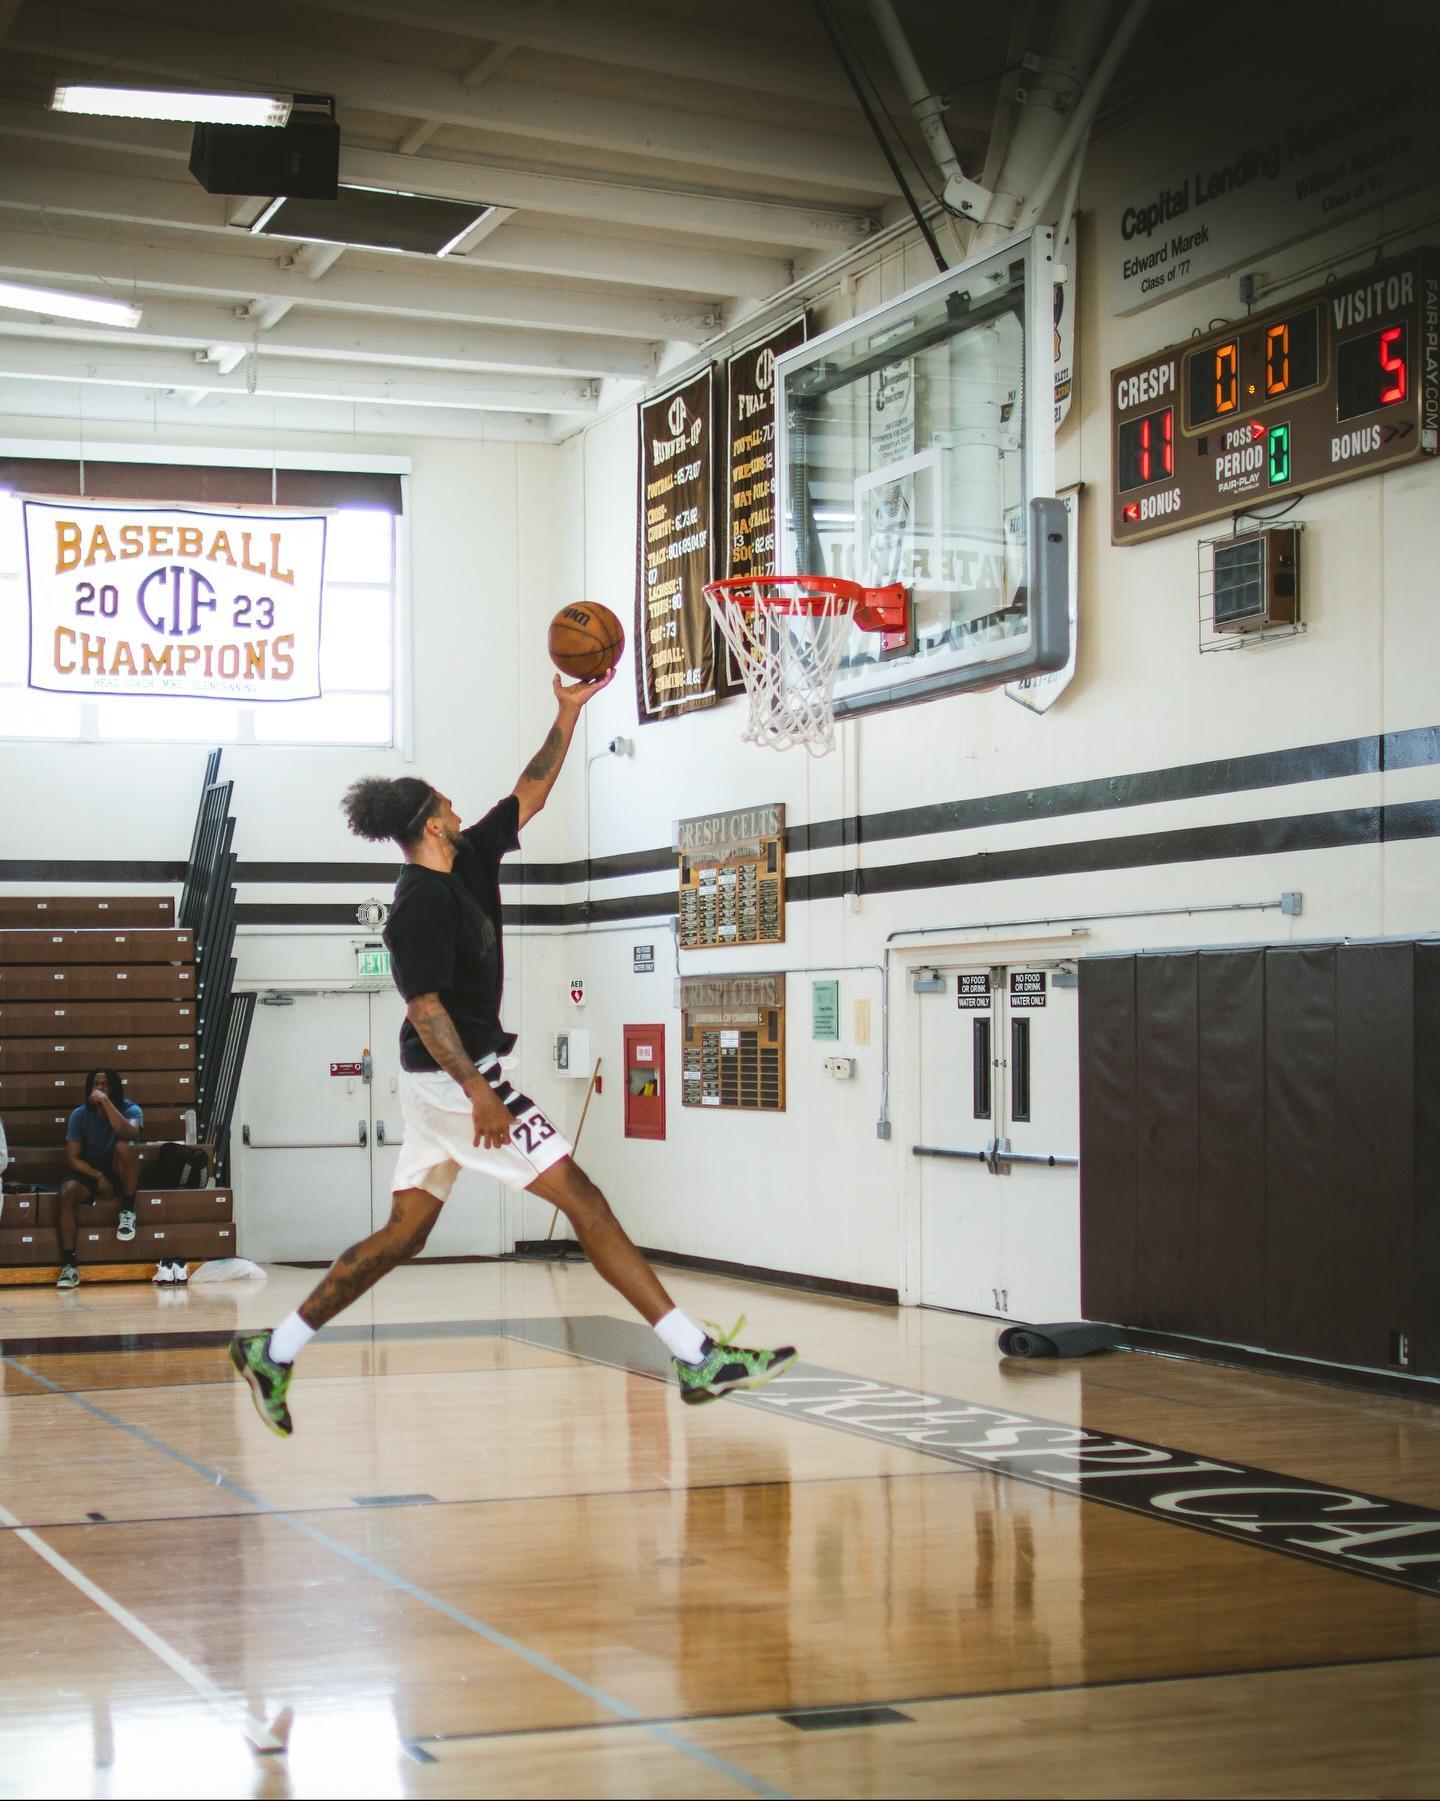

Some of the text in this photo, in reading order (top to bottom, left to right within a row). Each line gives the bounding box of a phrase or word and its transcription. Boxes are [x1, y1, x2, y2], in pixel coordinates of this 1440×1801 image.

[1122, 144, 1282, 240] Capital Lending
[1123, 224, 1210, 280] Edward Marek
[1141, 260, 1191, 292] Class of '77
[1333, 272, 1414, 330] VISITOR
[1380, 327, 1405, 404] 5
[1426, 279, 1438, 430] FAIR-PLAY.COM
[1118, 361, 1175, 410] CRESPI
[668, 396, 687, 436] CIF
[1140, 410, 1173, 481] 11
[1226, 426, 1252, 450] POSS
[1270, 427, 1288, 482] 0
[1332, 425, 1382, 463] BONUS
[1216, 445, 1263, 480] PERIOD
[1218, 472, 1260, 493] FAIR-PLAY
[1140, 488, 1180, 521] BONUS
[55, 520, 294, 586] BASEBALL
[75, 565, 275, 636] 20 CIF 23
[54, 625, 294, 680] CHAMPIONS
[678, 808, 778, 848] CRESPI CELTS
[971, 976, 985, 984] FOOD
[1024, 983, 1041, 991] DRINK
[1025, 974, 1040, 982] FOOD
[959, 998, 989, 1007] WATER ONLY
[1012, 997, 1044, 1005] WATER ONLY
[513, 1113, 557, 1154] 23
[730, 1377, 1440, 1572] CRESPI CA
